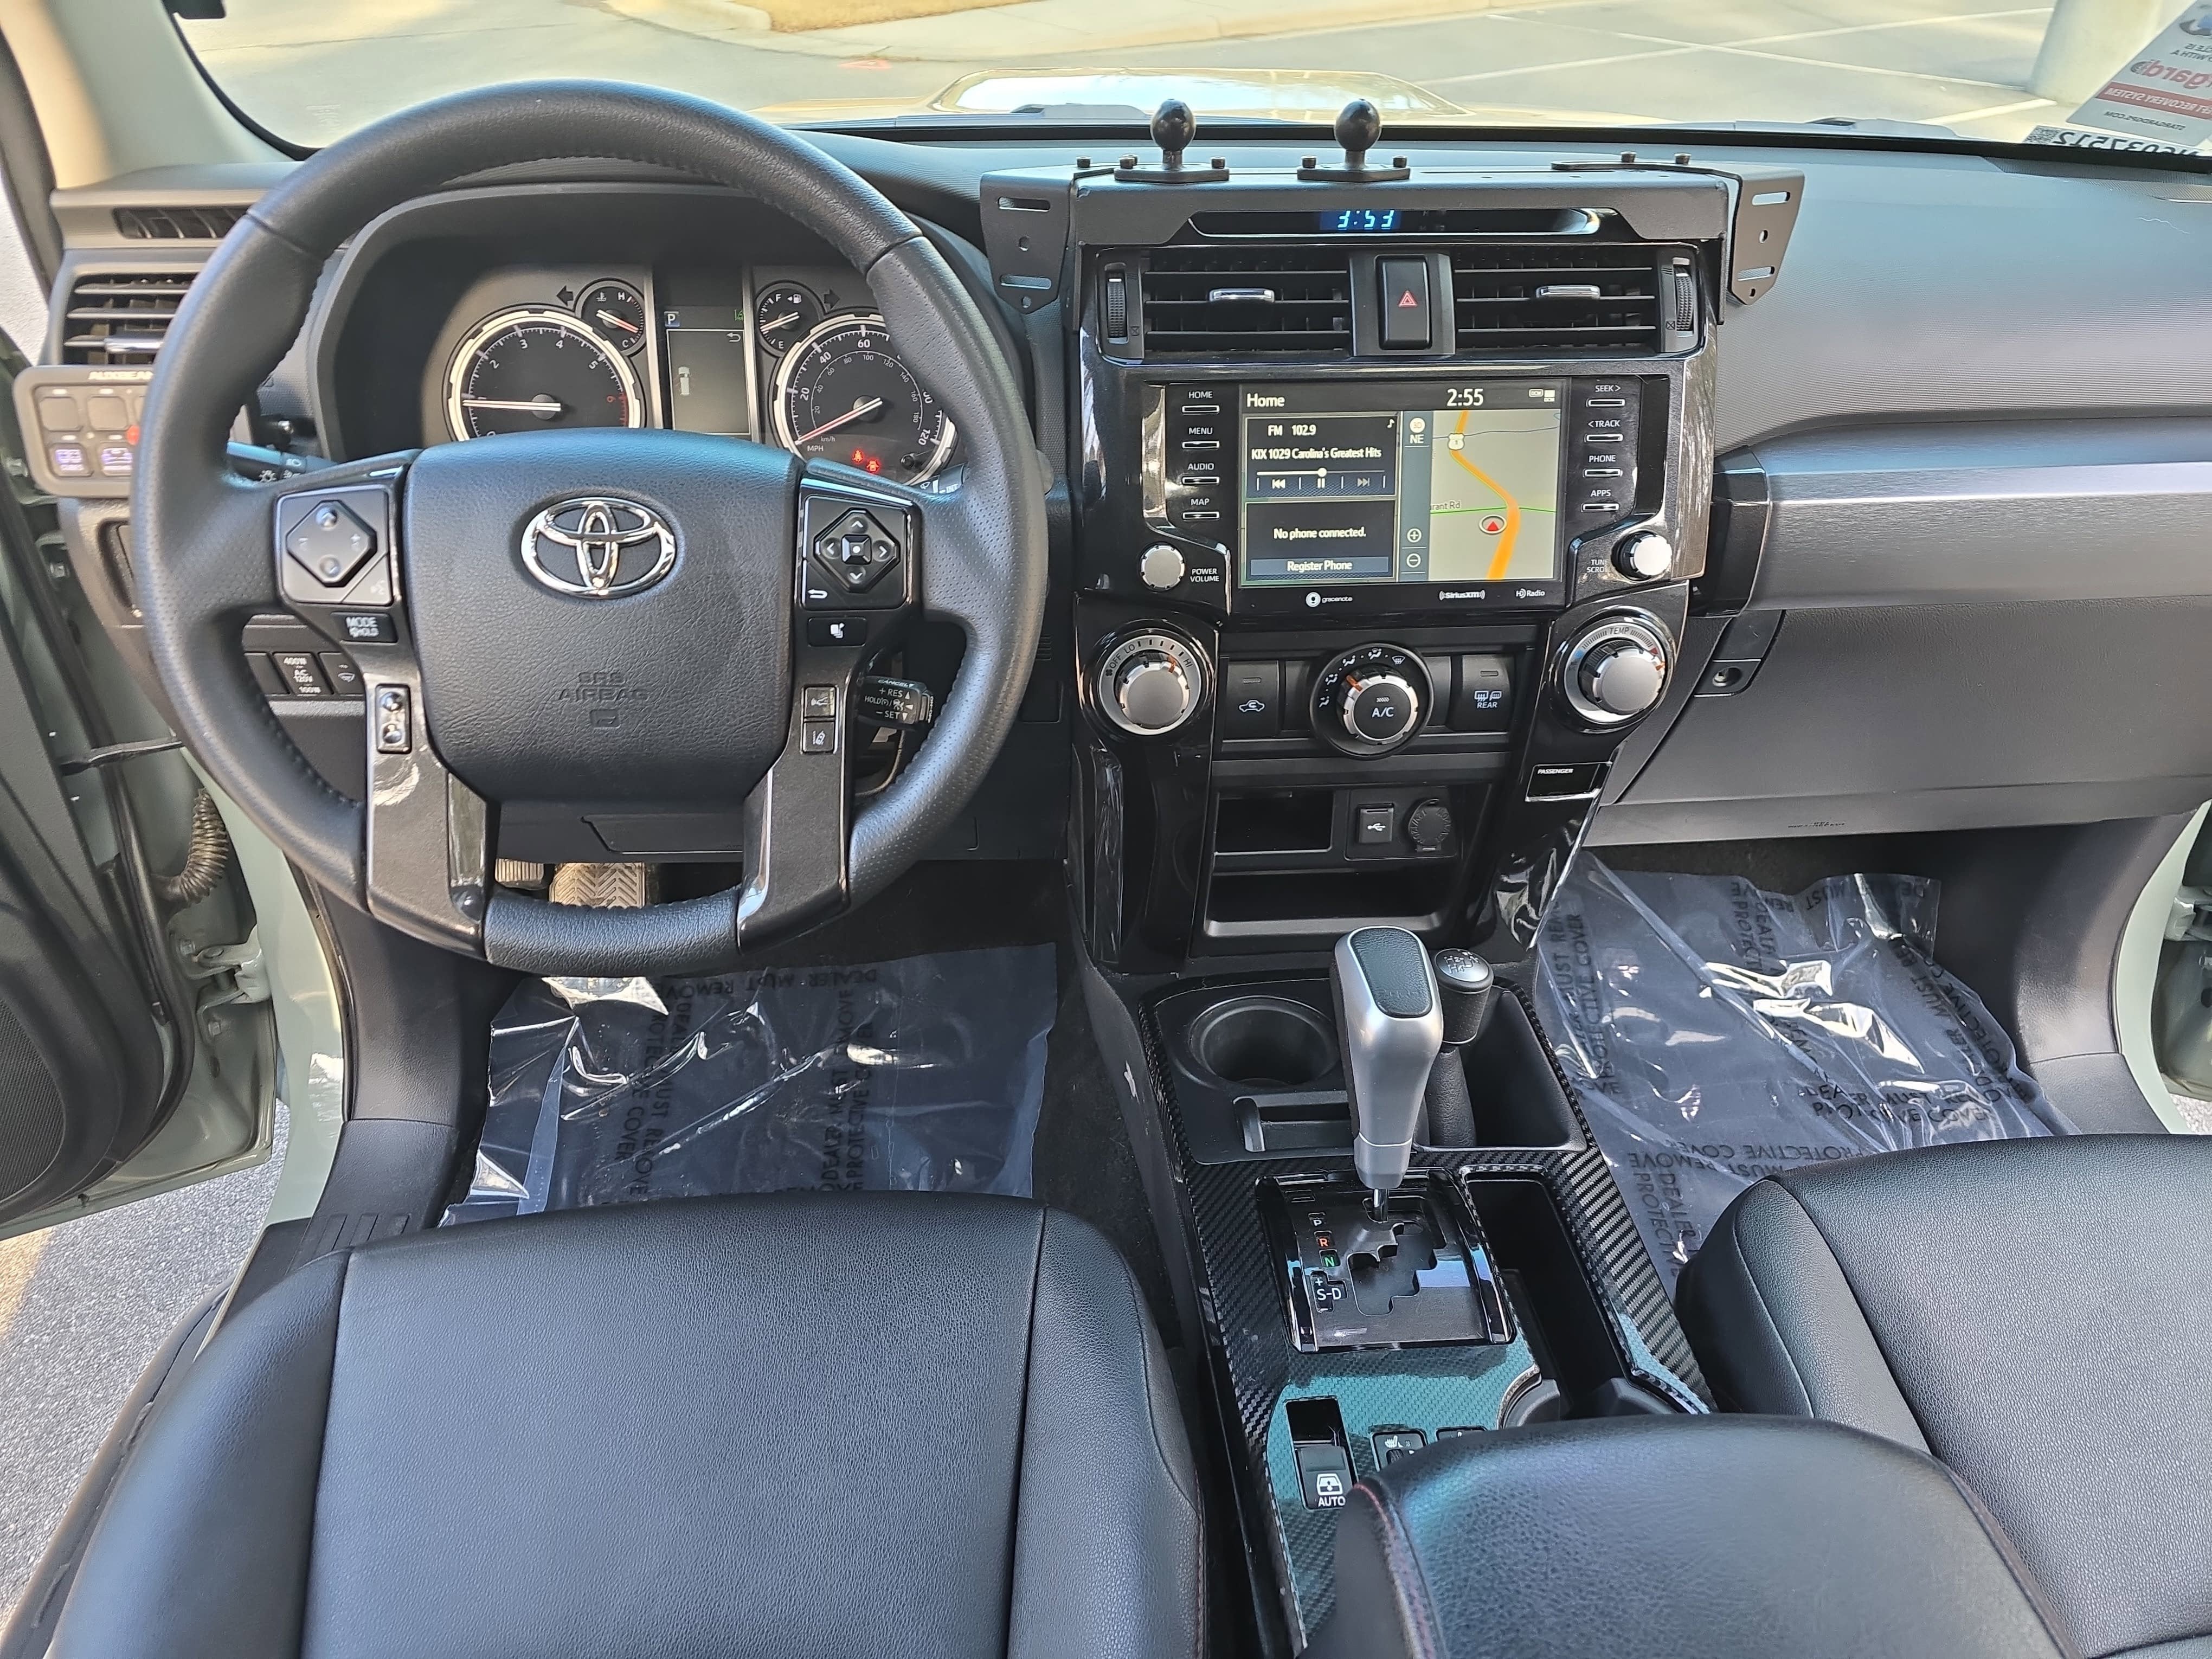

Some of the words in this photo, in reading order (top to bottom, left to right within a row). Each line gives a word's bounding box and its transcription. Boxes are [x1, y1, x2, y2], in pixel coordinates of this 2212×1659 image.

[775, 293, 781, 302] F
[667, 314, 676, 325] P
[520, 339, 529, 349] 3
[555, 340, 564, 349] 4
[857, 339, 871, 348] 60
[819, 352, 832, 364] 40
[490, 360, 500, 369] 2
[589, 361, 599, 370] 5
[800, 387, 810, 401] 20
[1446, 388, 1484, 407] 2:55
[1247, 393, 1285, 407] Home
[1268, 425, 1283, 436] FM
[1291, 425, 1317, 436] 102.9
[918, 428, 931, 446] 120
[1410, 434, 1424, 444] NE
[1251, 448, 1267, 460] KIX
[1291, 447, 1329, 459] Carolina's
[1330, 447, 1364, 459] Greatest
[1365, 447, 1382, 458] Hits
[1274, 528, 1288, 539] No
[1289, 528, 1317, 540] phone
[1319, 526, 1367, 538] connected.
[1287, 560, 1323, 573] Register
[1324, 560, 1352, 570] Phone
[346, 616, 378, 628] MODE
[1109, 653, 1122, 668] OFF
[1124, 644, 1135, 654] LO
[1183, 658, 1193, 667] HI
[864, 696, 881, 704] HOLD
[1372, 707, 1394, 717] A/C
[1319, 1238, 1328, 1246] R
[1324, 1257, 1335, 1266] N
[1318, 1496, 1346, 1507] AUTO
